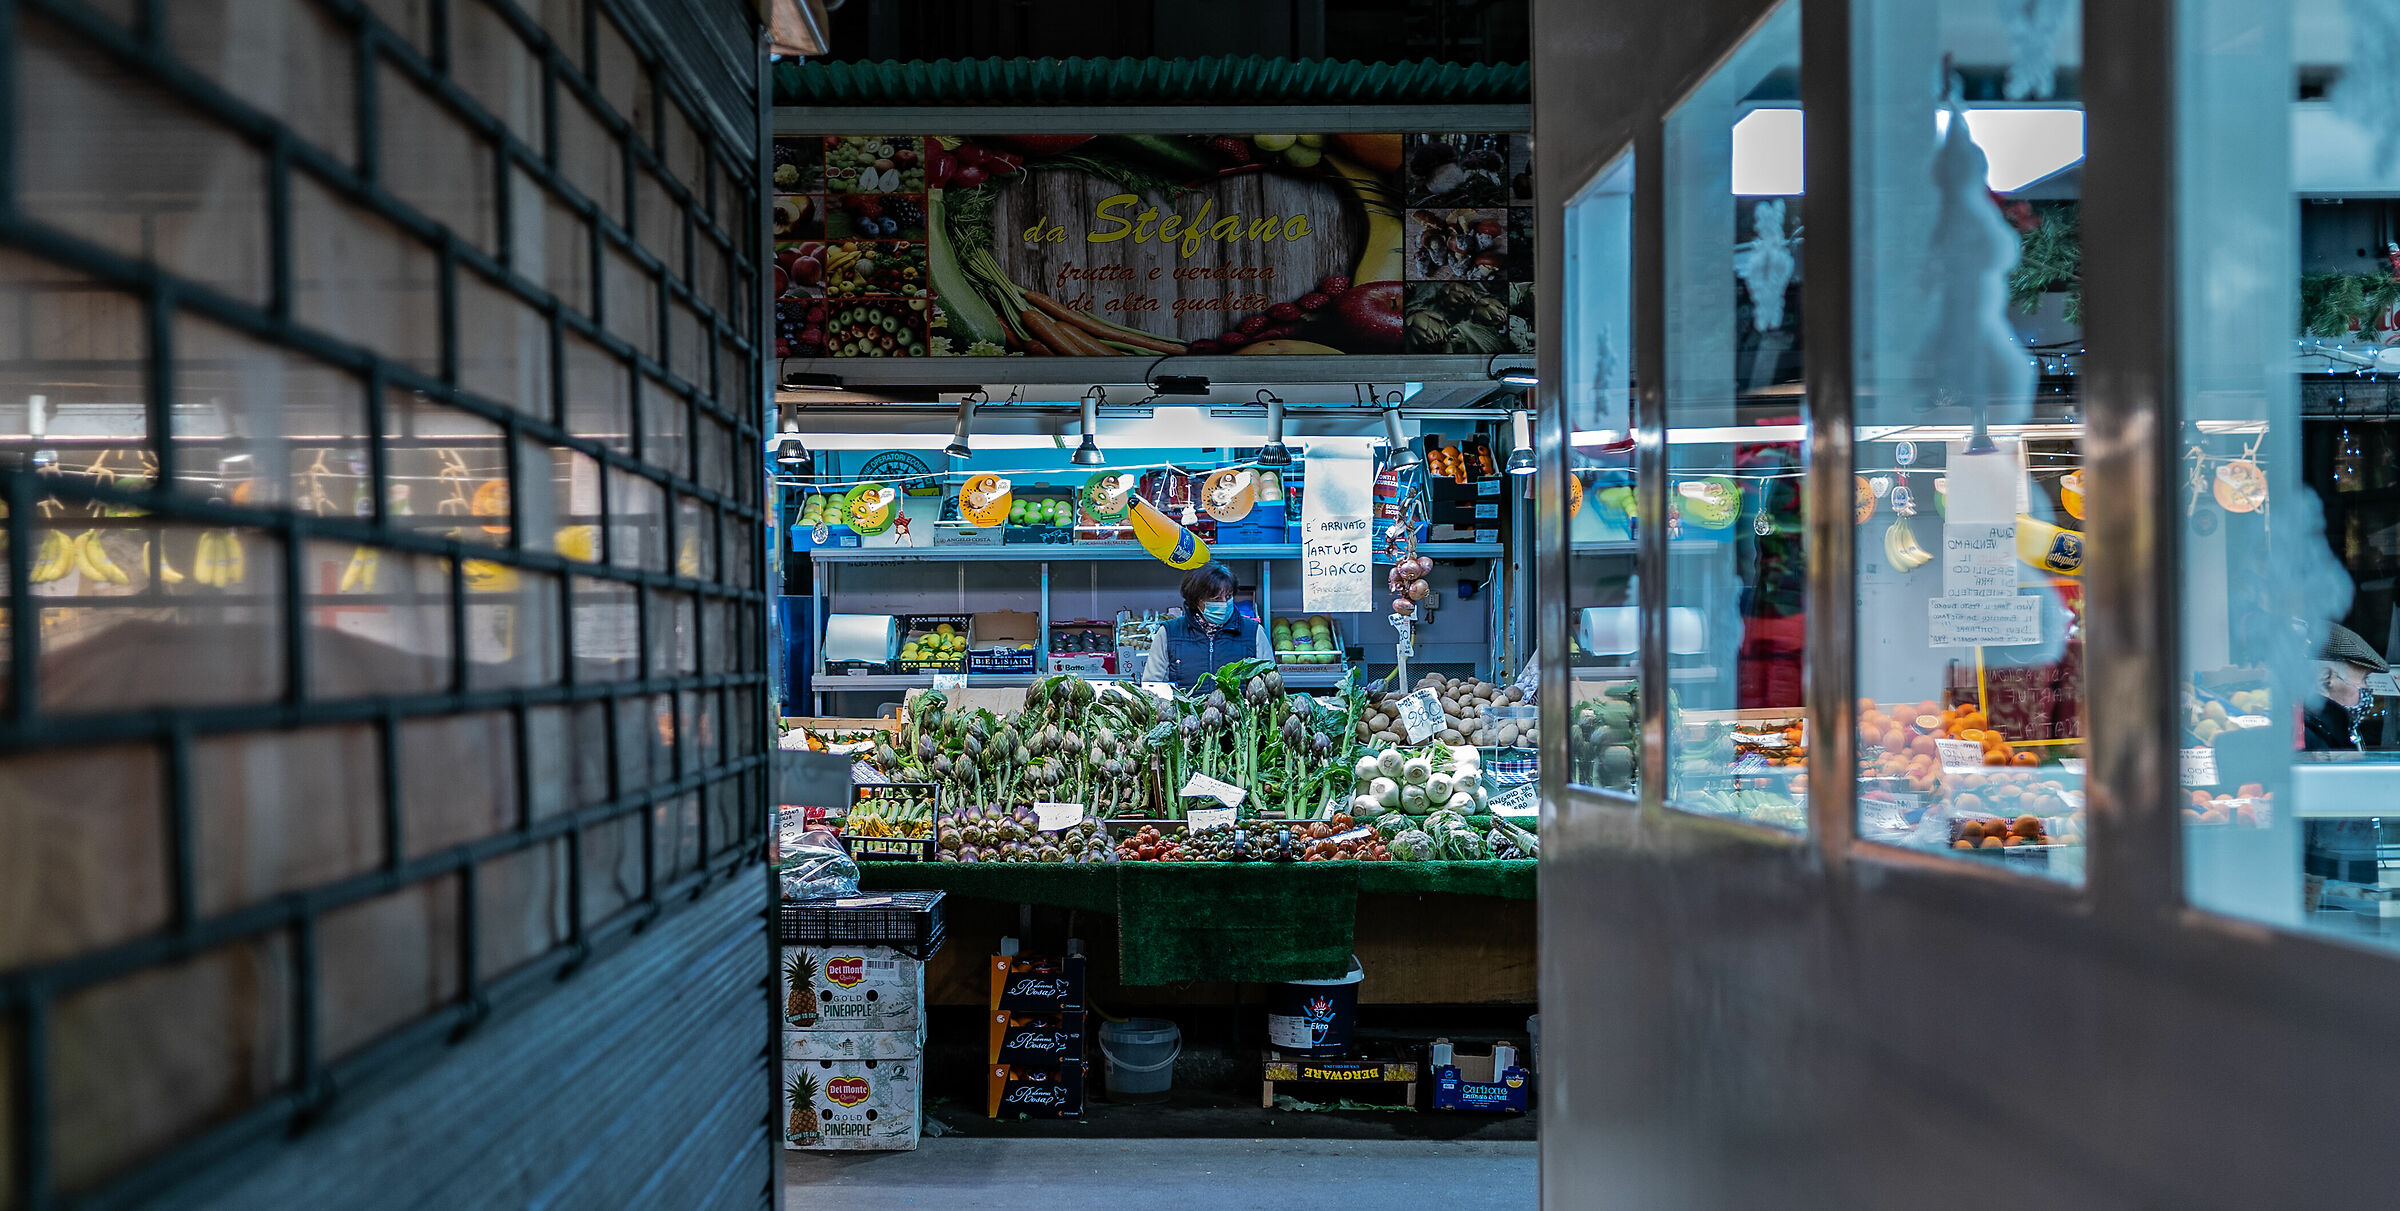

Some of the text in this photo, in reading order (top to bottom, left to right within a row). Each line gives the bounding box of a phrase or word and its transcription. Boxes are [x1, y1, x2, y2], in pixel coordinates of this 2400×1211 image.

[1023, 194, 1313, 258] da Stefano
[1056, 261, 1277, 288] frutta e verdura
[1067, 292, 1270, 318] di alta qualità
[1320, 519, 1366, 531] ARRIVATO
[1304, 539, 1358, 557] TARTUFO
[1308, 560, 1366, 576] BIANCO
[829, 966, 842, 975] Del
[1007, 979, 1056, 997] Rosa
[1034, 980, 1053, 989] donna
[824, 1004, 872, 1017] PINEAPPLE
[1311, 1022, 1329, 1030] Ekro
[1007, 1032, 1055, 1051] Rosa
[1033, 1034, 1052, 1042] donna
[1303, 1067, 1379, 1081] BERGWARE
[829, 1085, 868, 1094] Del Monte
[1005, 1086, 1054, 1105] Rosa
[1032, 1087, 1051, 1096] donna
[825, 1123, 872, 1136] PINEAPPLE
